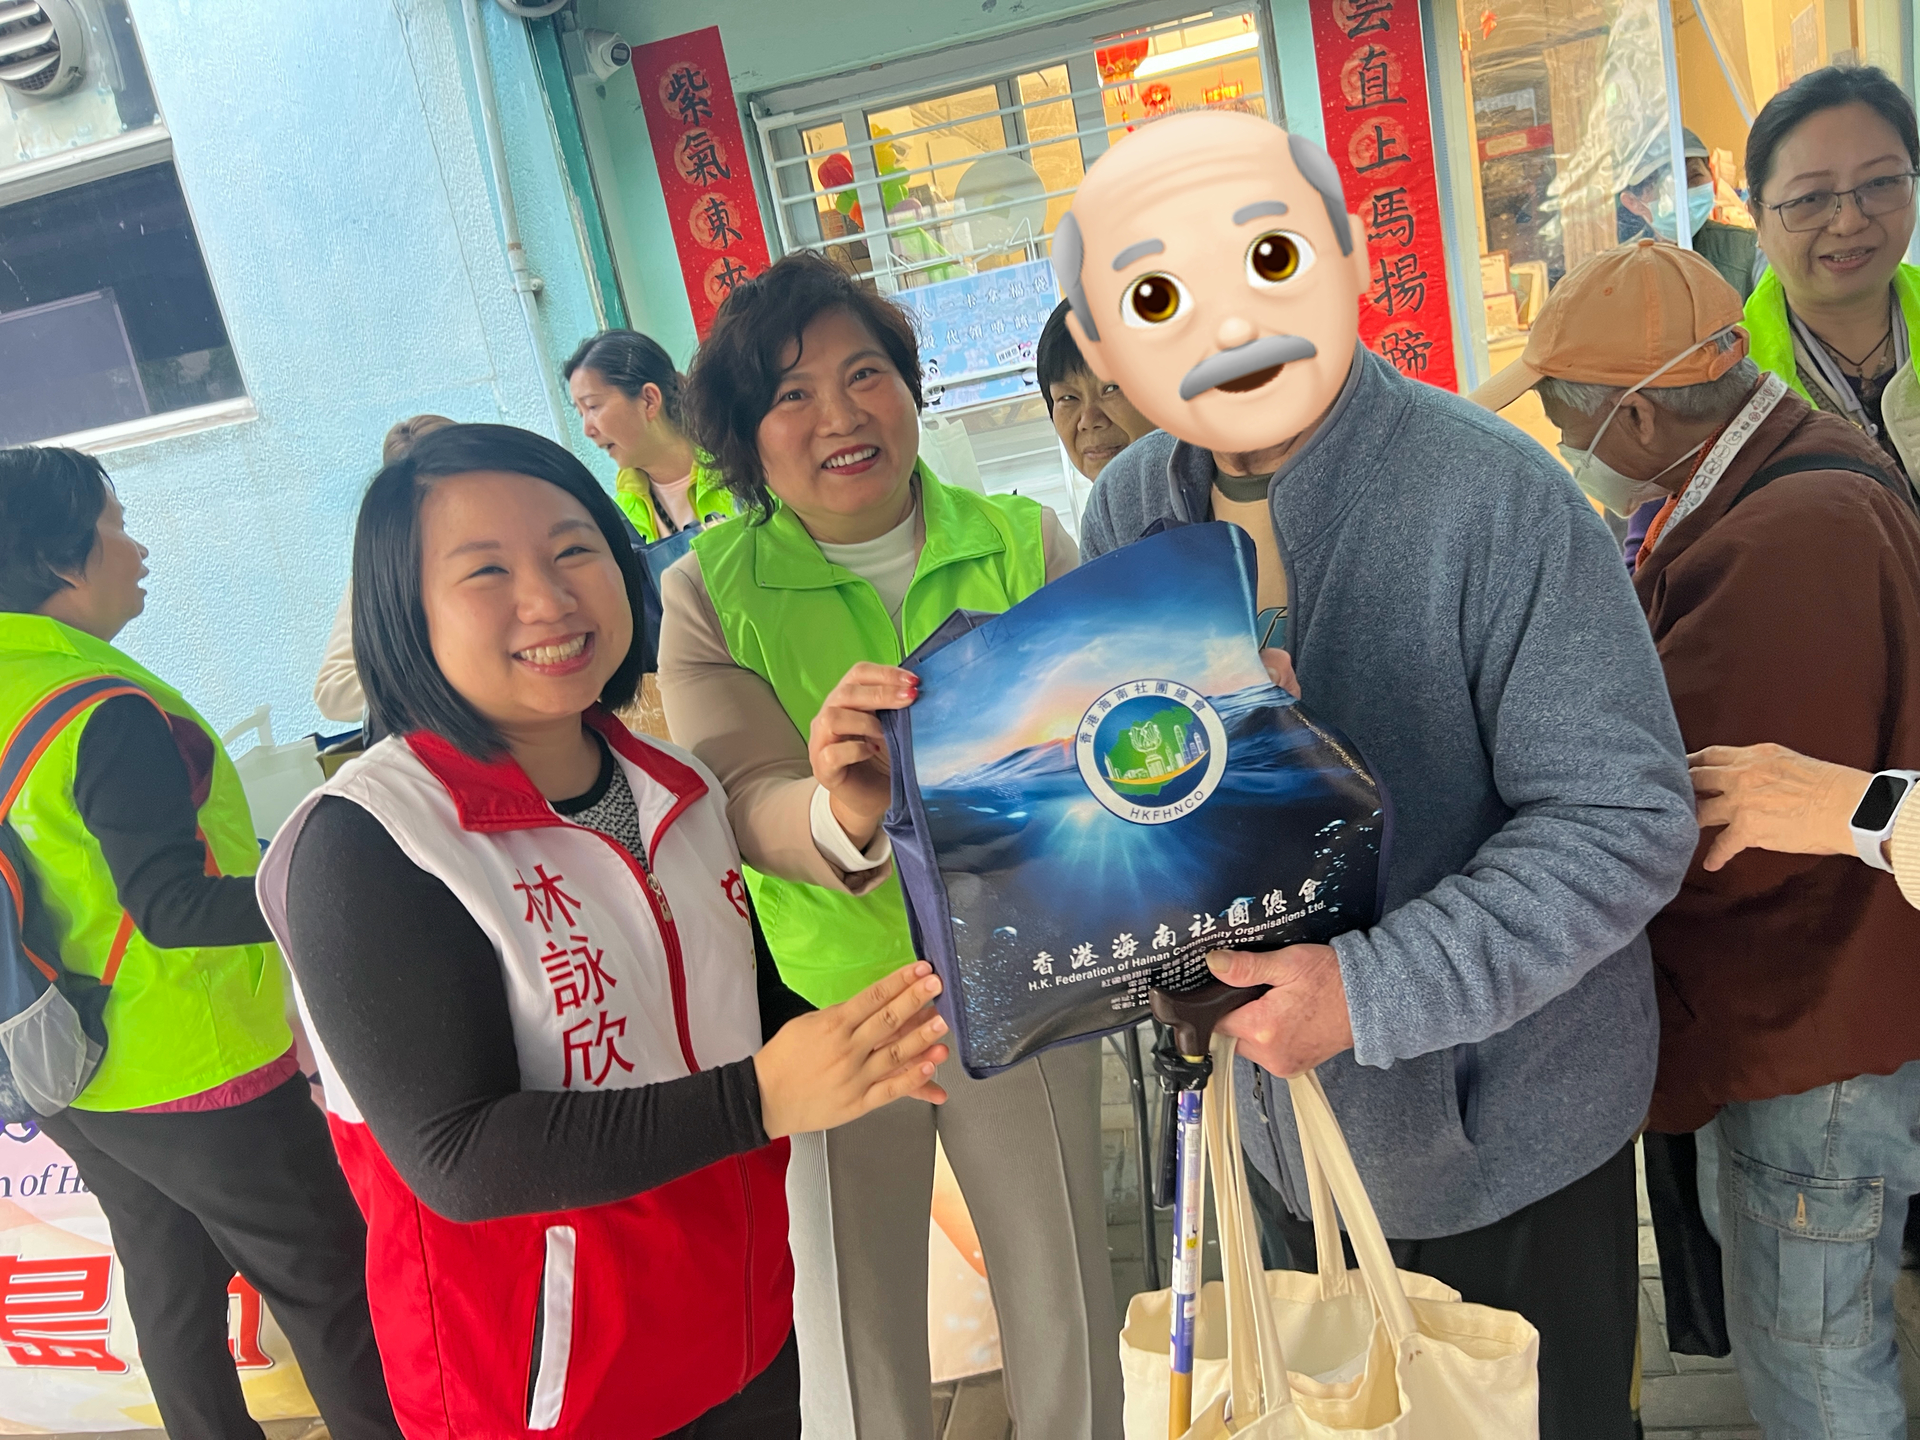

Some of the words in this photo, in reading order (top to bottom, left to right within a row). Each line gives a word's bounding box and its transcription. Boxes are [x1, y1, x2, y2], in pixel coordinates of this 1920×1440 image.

[1079, 682, 1207, 744] 香港海南社團總會
[1129, 790, 1205, 821] HKFHNCO
[1028, 979, 1053, 992] H.K.
[1055, 966, 1115, 986] Federation
[1117, 959, 1130, 972] of
[1131, 952, 1171, 969] Hainan
[1172, 929, 1233, 956] Community
[1234, 908, 1307, 936] Organisations
[1308, 900, 1327, 917] Ltd.
[1031, 877, 1322, 976] 香港海南社團總會
[513, 863, 636, 1089] 林詠欣
[20, 1163, 57, 1197] of
